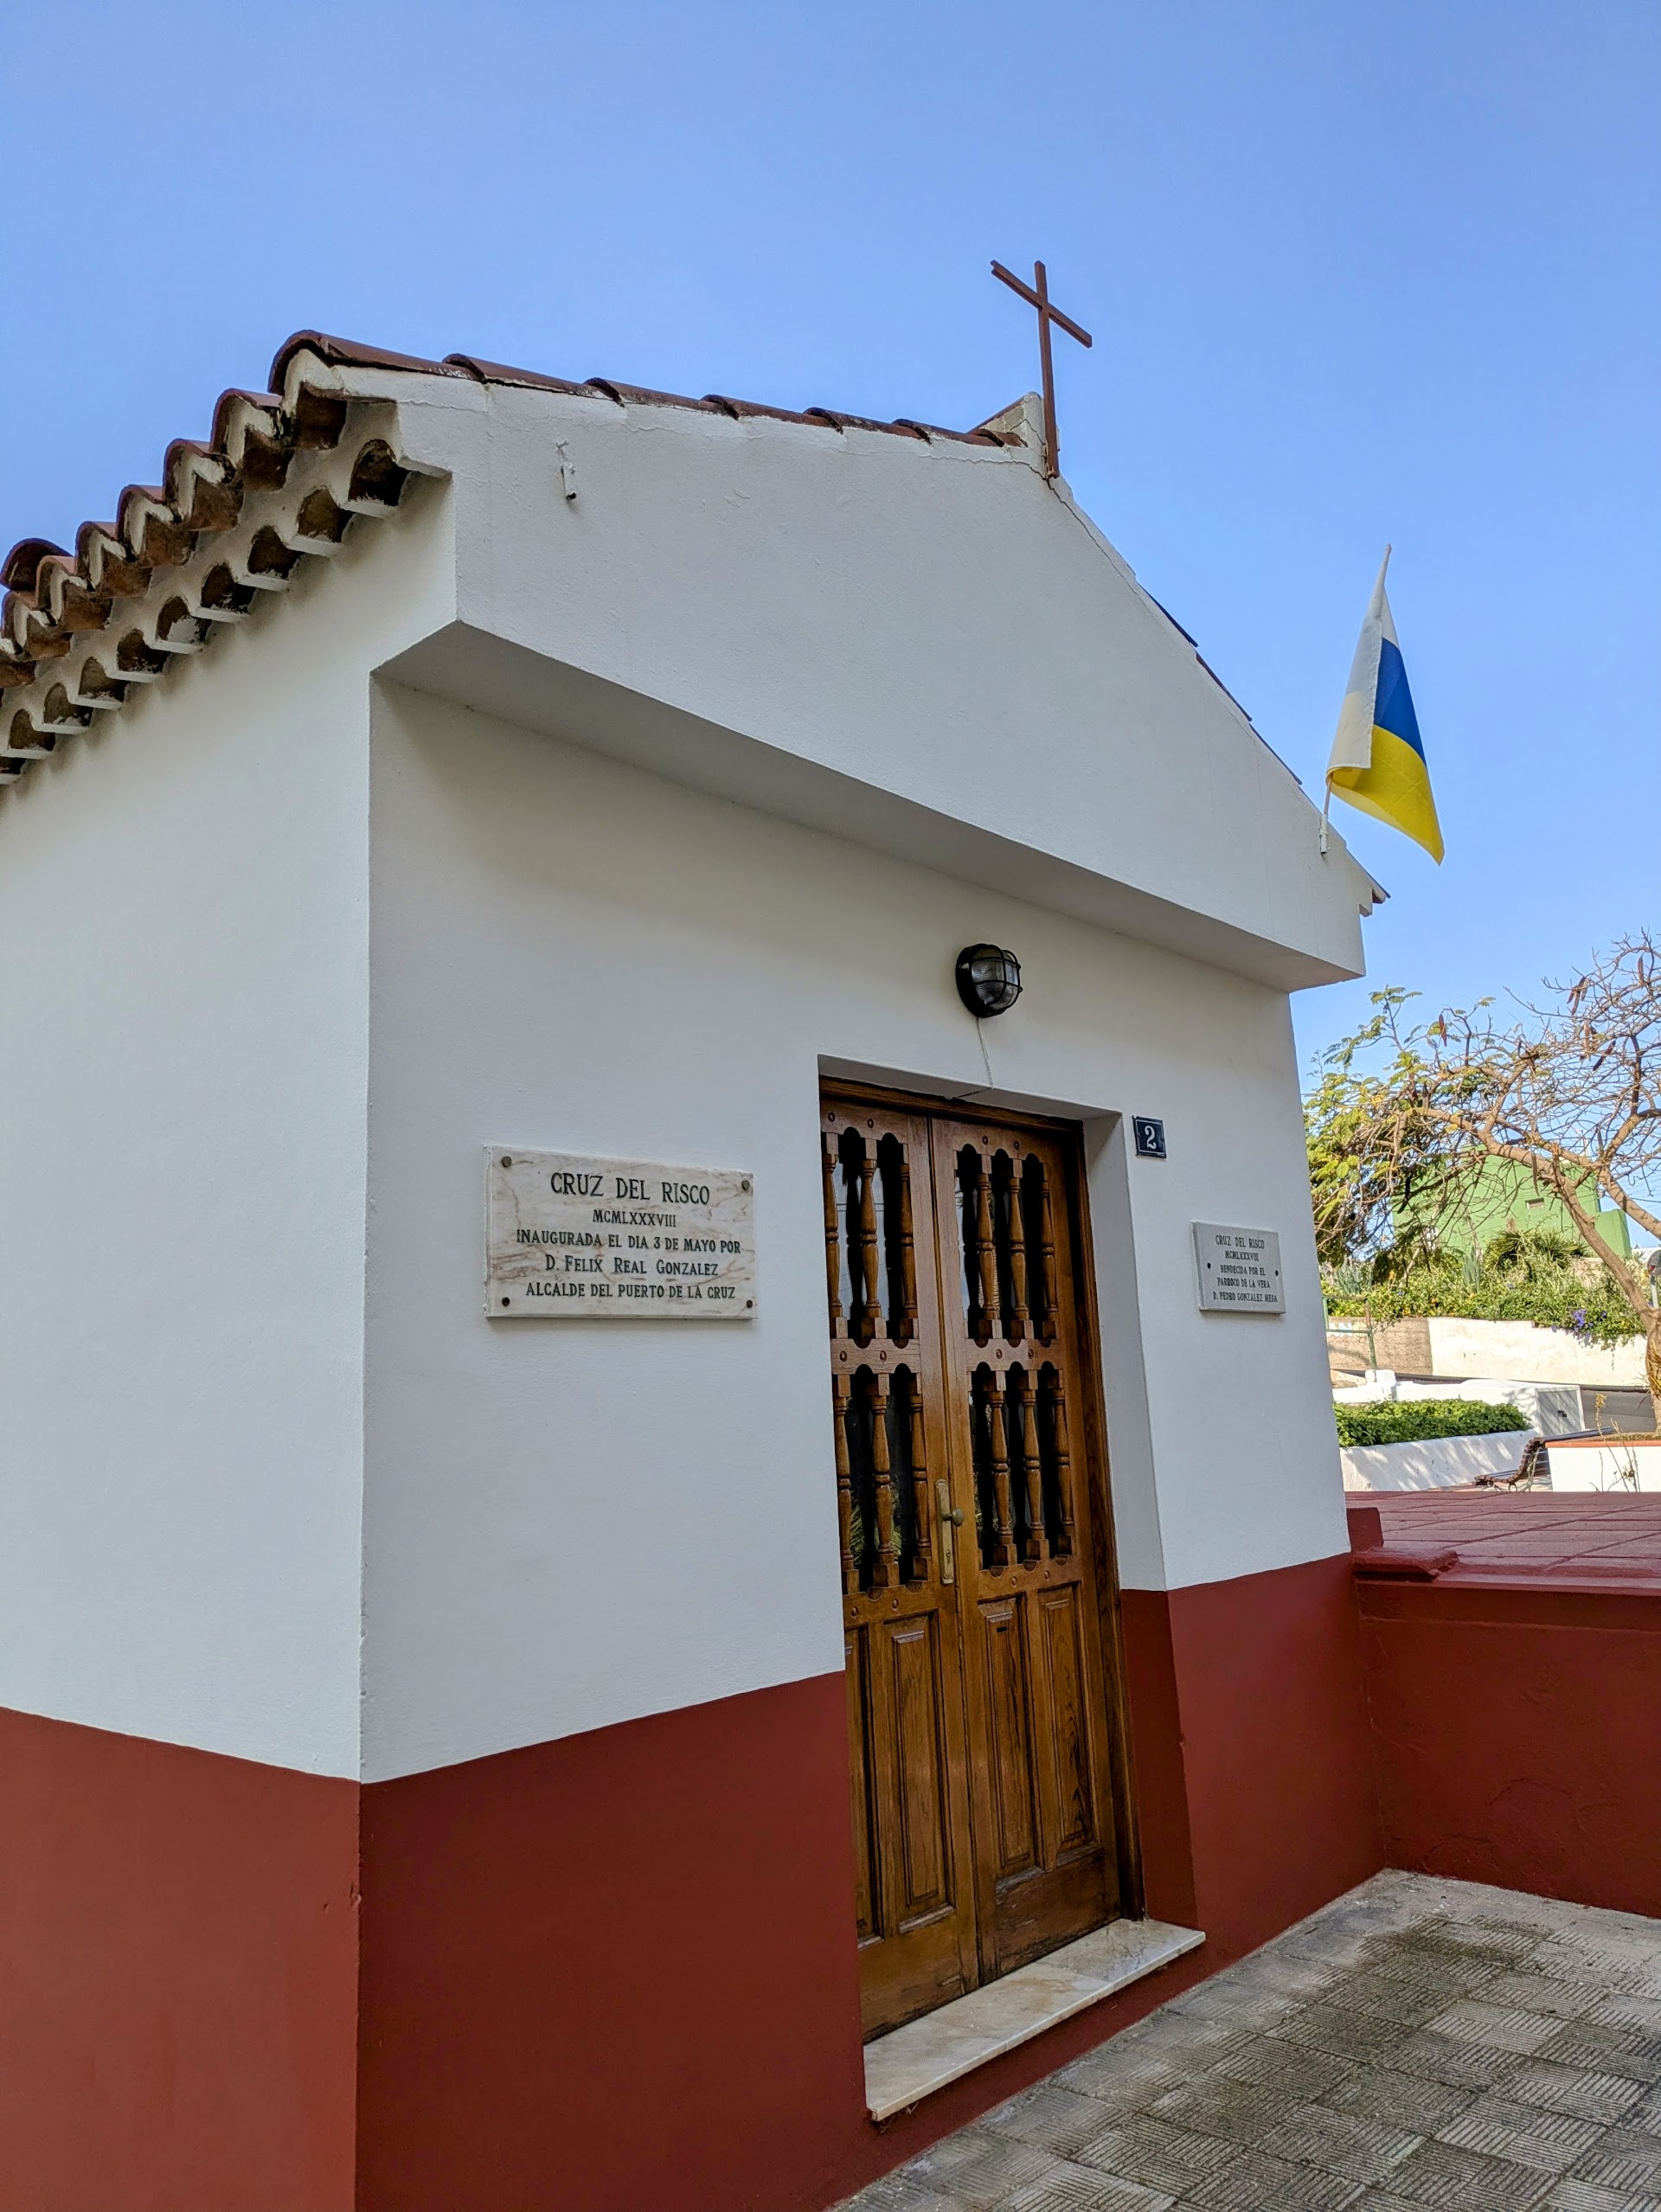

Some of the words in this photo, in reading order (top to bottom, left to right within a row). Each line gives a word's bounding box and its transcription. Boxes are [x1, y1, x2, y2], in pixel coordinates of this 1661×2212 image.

[1145, 1125, 1157, 1149] 2
[551, 1172, 604, 1196] CRUZ
[616, 1178, 651, 1200] DEL
[662, 1183, 710, 1204] RISCO
[593, 1209, 677, 1227] MCMLXXXVIII
[516, 1229, 601, 1247] INAUGURADA
[608, 1234, 622, 1247] EL
[628, 1236, 649, 1249] DIA
[654, 1237, 661, 1249] 3
[665, 1237, 678, 1250] DE
[683, 1239, 716, 1253] MAYO
[721, 1241, 741, 1253] POR
[1215, 1235, 1231, 1246] CRUZ
[1235, 1237, 1246, 1247] DEL
[1249, 1239, 1264, 1249] RISCO
[546, 1254, 559, 1270] D.
[565, 1255, 603, 1273] FELIX
[614, 1258, 646, 1274] REAL
[657, 1260, 718, 1275] GONZALEZ
[1249, 1266, 1258, 1275] POR
[526, 1283, 585, 1297] ALCALDE
[591, 1284, 612, 1297] DEL
[618, 1285, 664, 1298] PUERTO
[669, 1286, 683, 1298] DE
[688, 1286, 702, 1298] LA
[708, 1286, 735, 1299] CRUZ
[1213, 1292, 1218, 1300] D.
